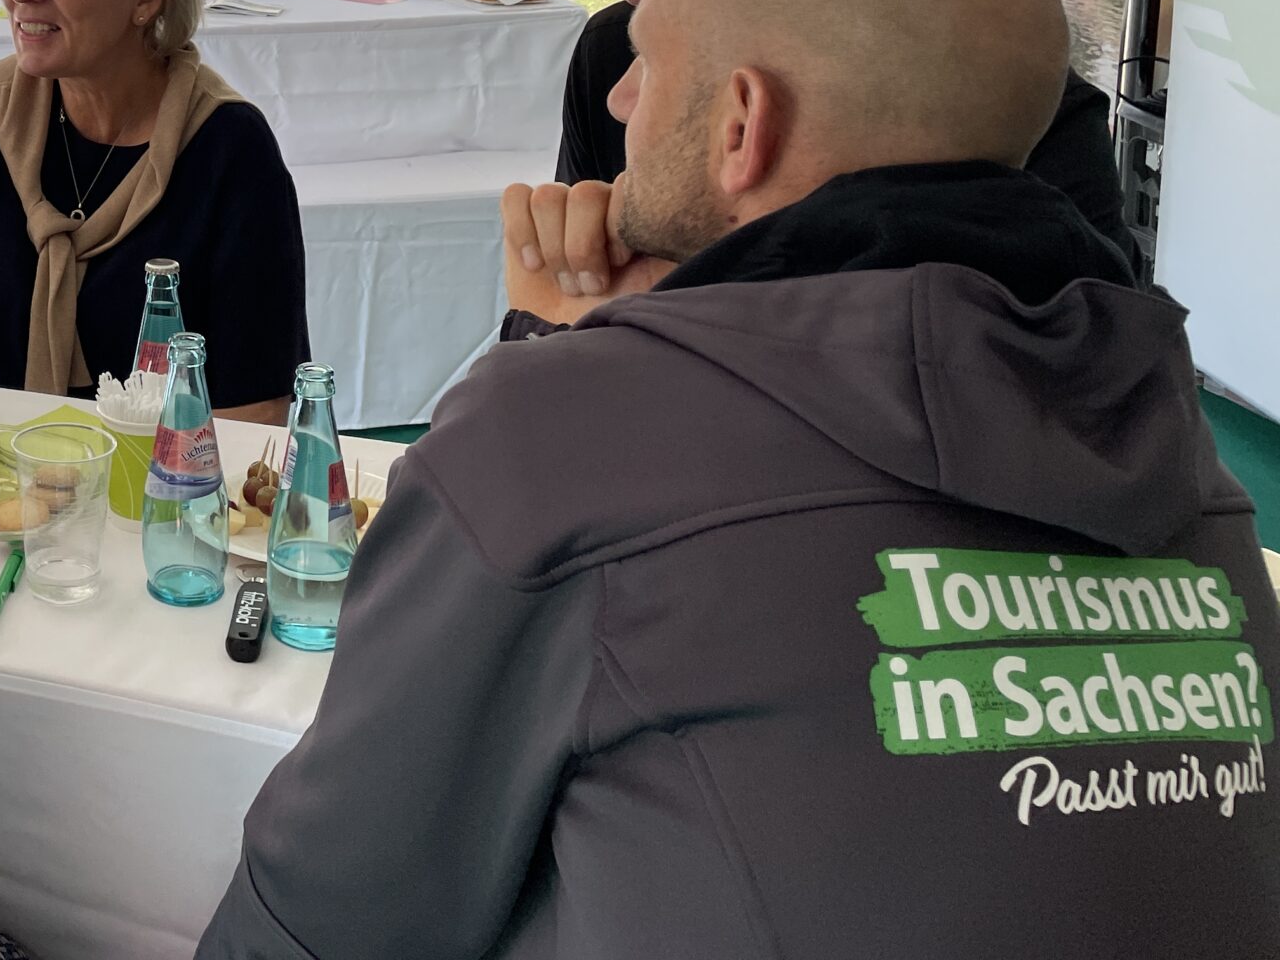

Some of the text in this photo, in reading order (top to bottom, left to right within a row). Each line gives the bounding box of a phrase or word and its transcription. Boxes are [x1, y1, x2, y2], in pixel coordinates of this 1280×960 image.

[889, 553, 1232, 632] Tourismus
[889, 651, 1262, 740] in Sachsen?
[1000, 734, 1267, 827] Passt mir gut!
